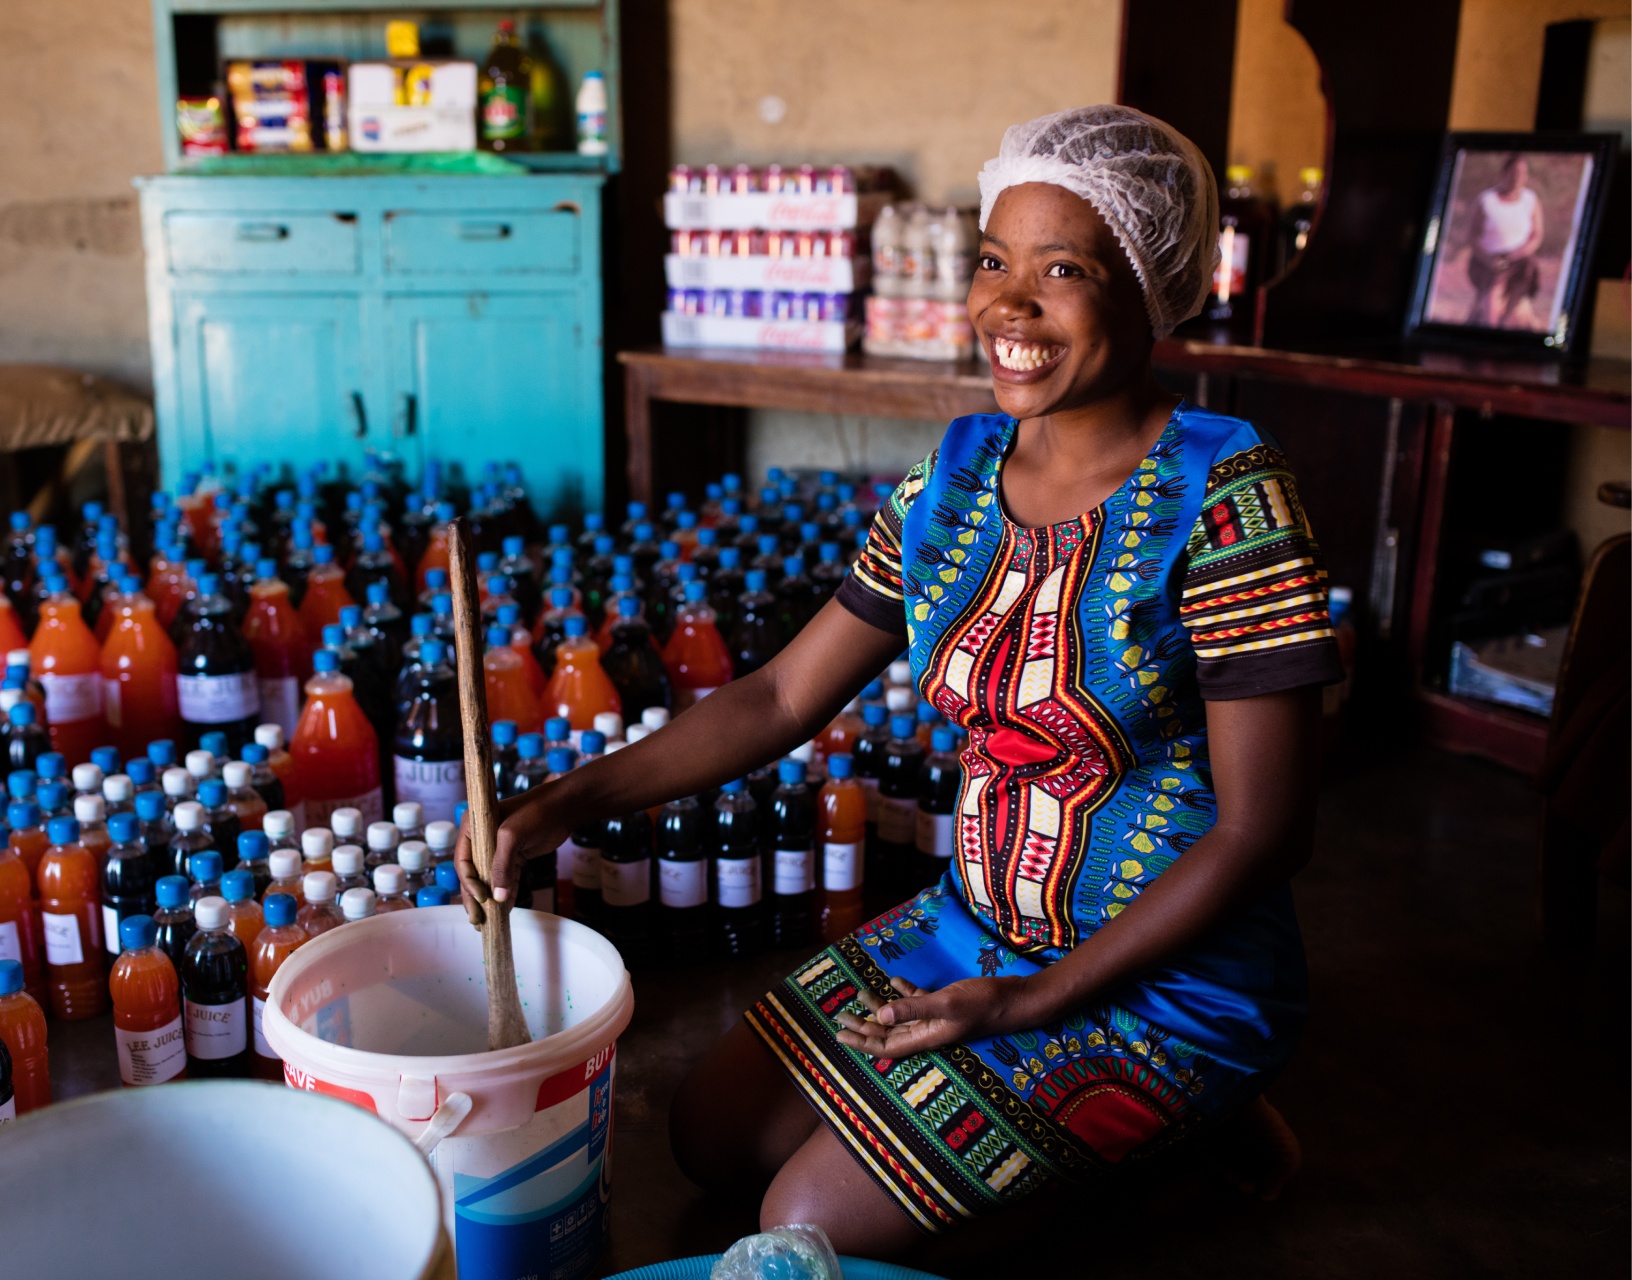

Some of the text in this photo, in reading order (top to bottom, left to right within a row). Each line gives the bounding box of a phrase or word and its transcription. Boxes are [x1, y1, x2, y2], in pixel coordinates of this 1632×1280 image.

[193, 1008, 232, 1024] JUICE
[126, 1040, 152, 1053] LEE
[585, 1045, 610, 1081] BUY
